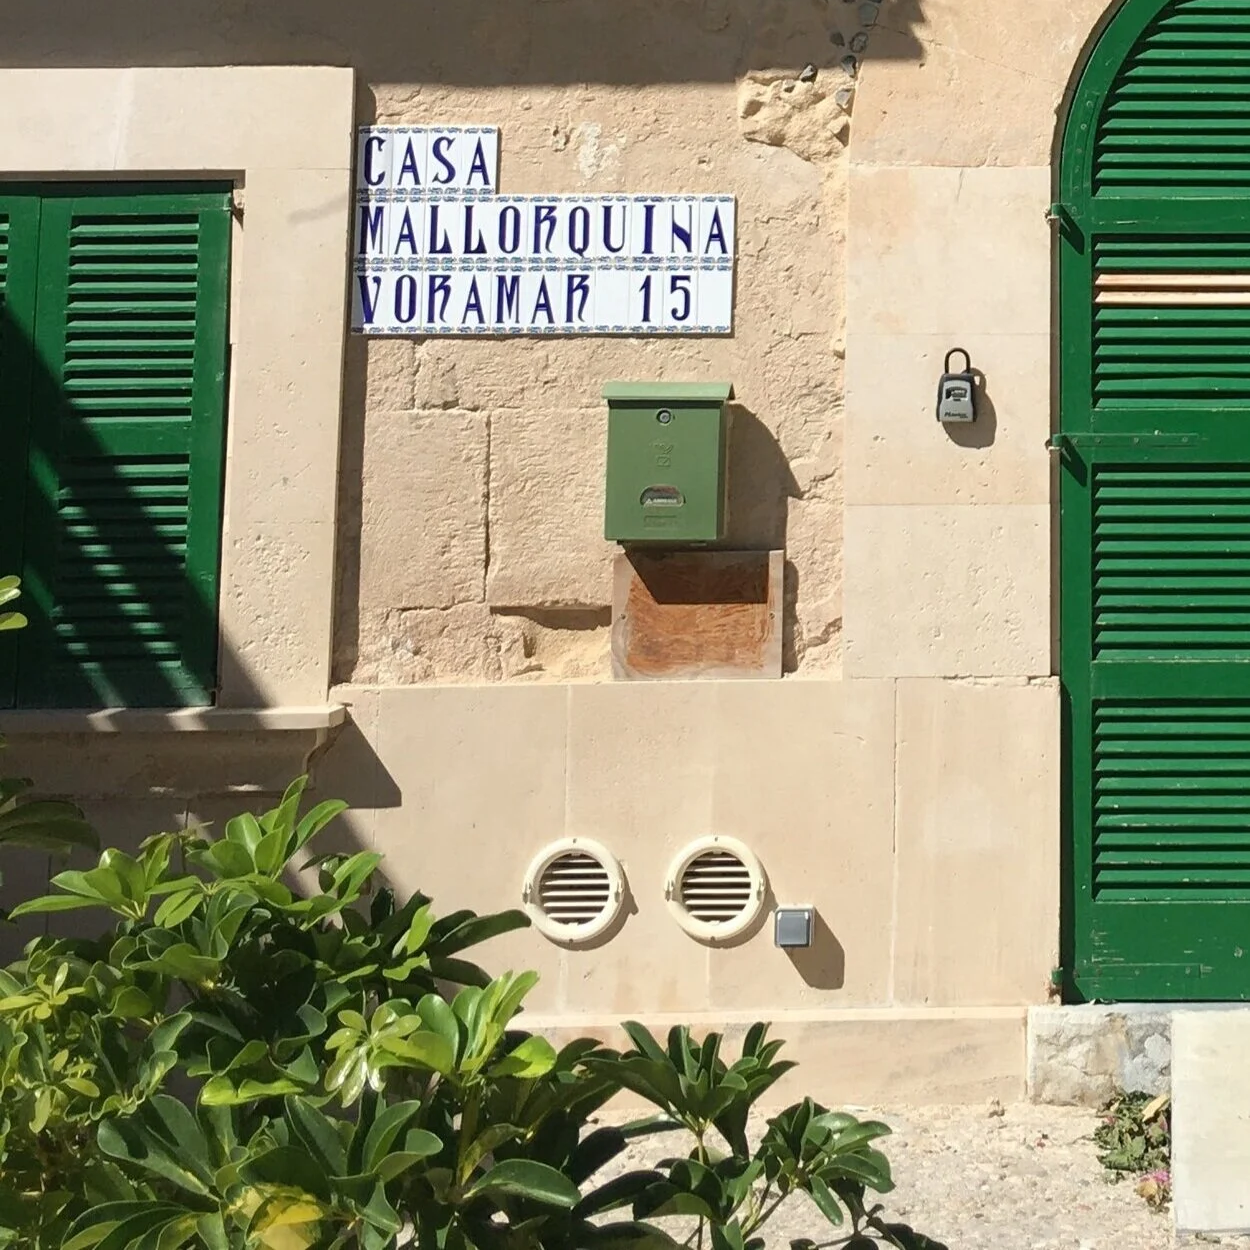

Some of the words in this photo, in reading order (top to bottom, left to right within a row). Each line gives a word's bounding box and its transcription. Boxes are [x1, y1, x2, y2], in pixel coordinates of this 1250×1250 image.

[363, 136, 491, 186] CASA
[358, 204, 729, 258] MALLORQUINA
[358, 274, 591, 324] VORAMAR
[638, 274, 693, 322] 15
